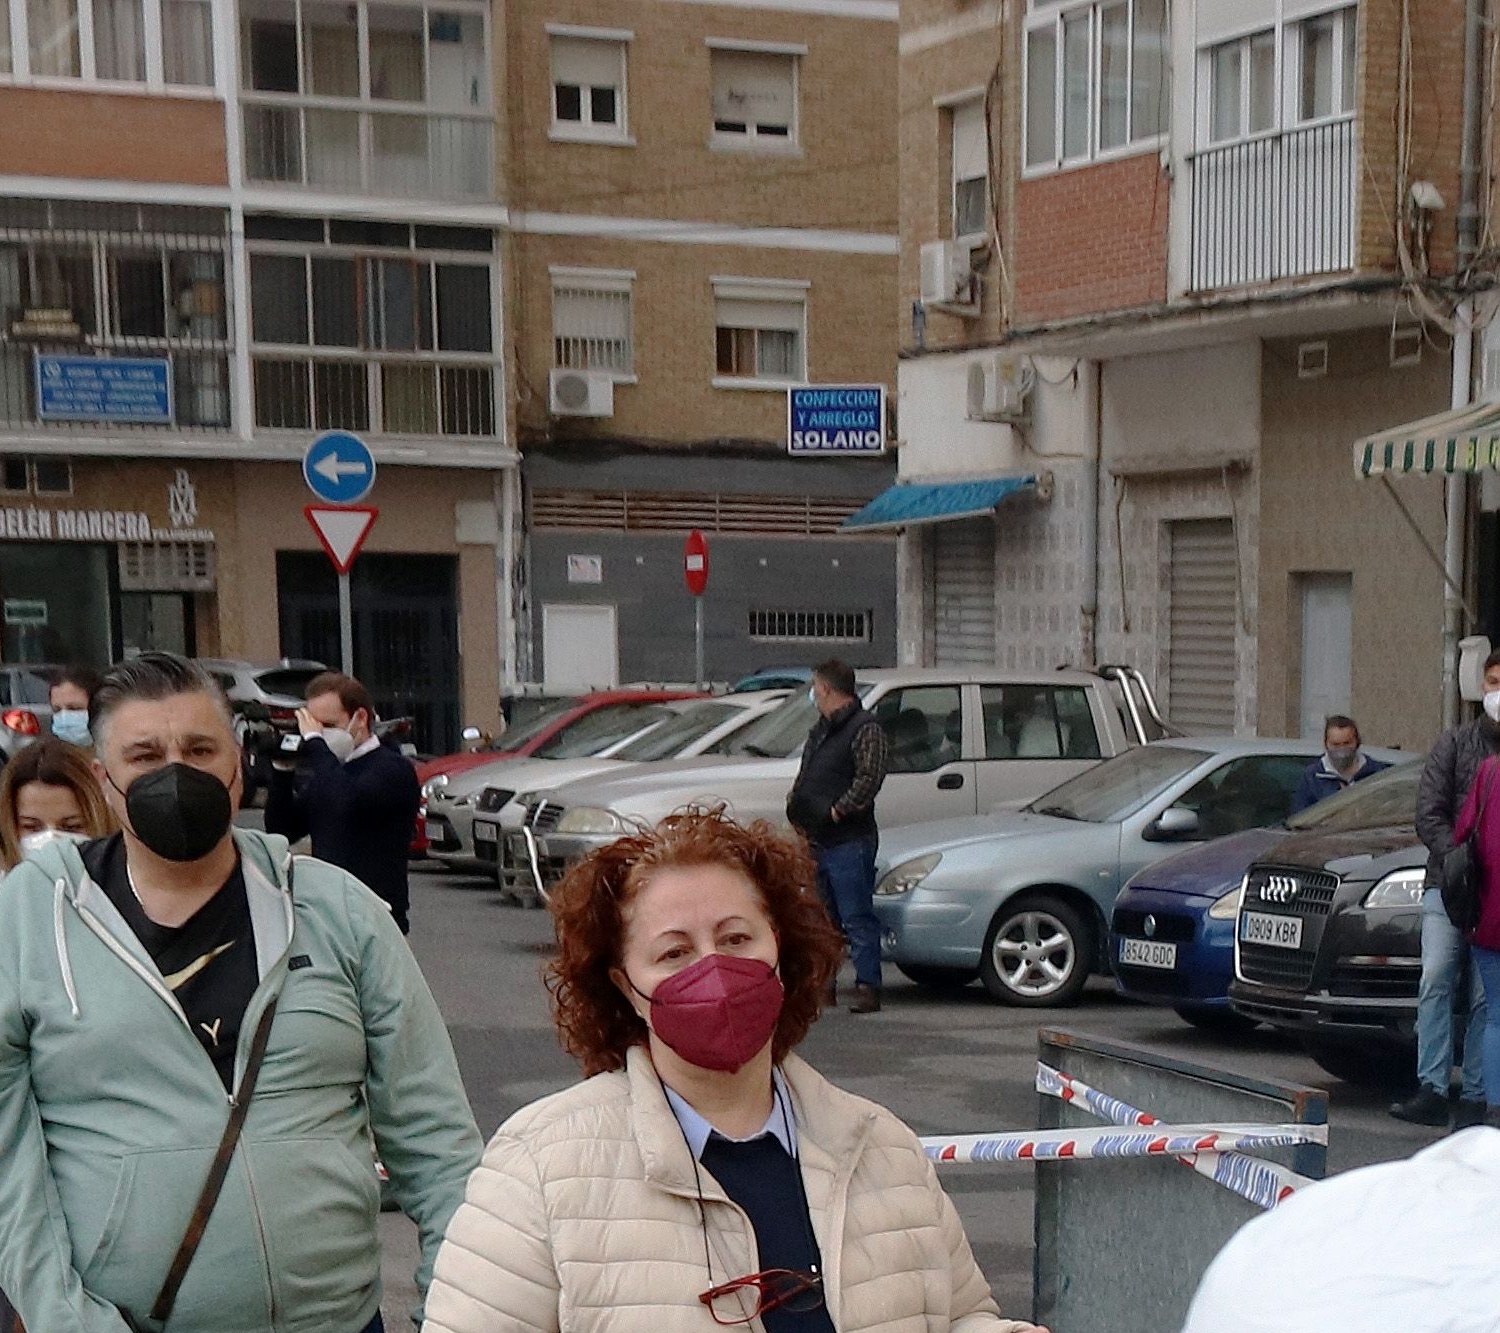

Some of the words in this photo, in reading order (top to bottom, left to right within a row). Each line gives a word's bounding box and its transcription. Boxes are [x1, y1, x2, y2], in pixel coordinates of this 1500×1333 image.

[798, 411, 805, 427] Y
[809, 411, 876, 428] ARREGLOS
[793, 430, 880, 449] SOLANO
[56, 510, 150, 542] MANCERA
[1248, 916, 1273, 940] 0909
[1274, 920, 1298, 944] KBR
[1125, 941, 1150, 962] 8542
